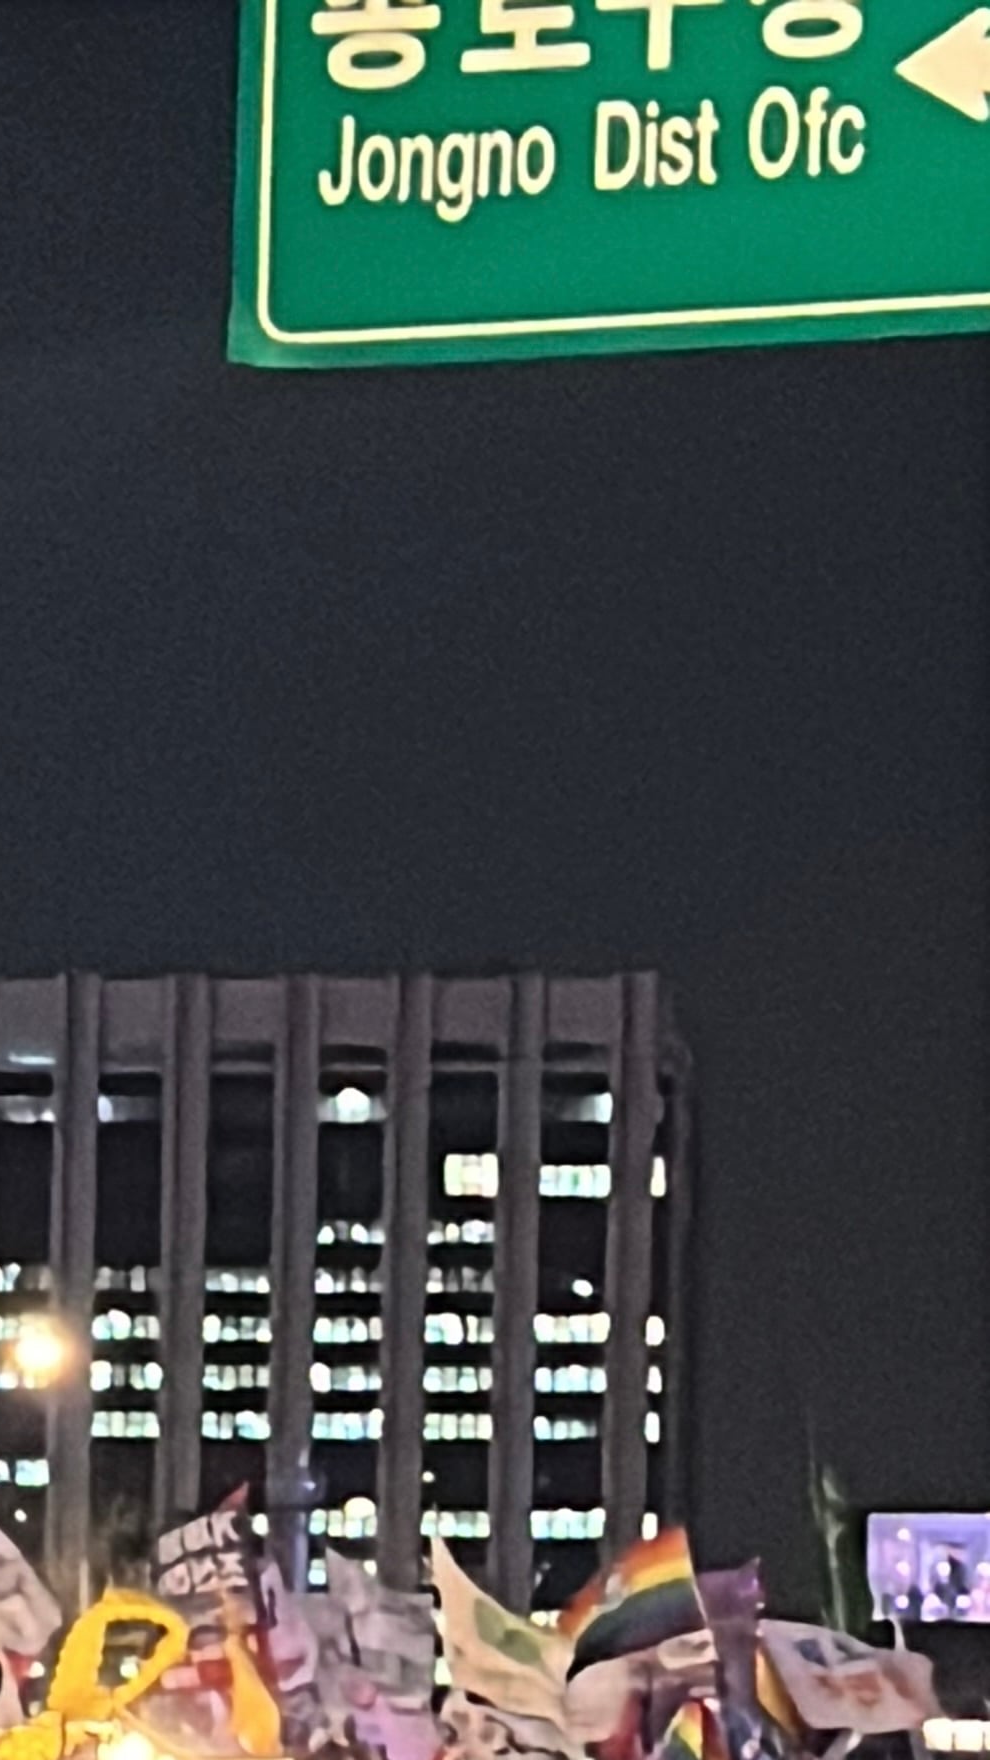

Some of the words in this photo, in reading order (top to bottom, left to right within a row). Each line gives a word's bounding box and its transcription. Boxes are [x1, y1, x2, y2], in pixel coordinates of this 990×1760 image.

[319, 115, 555, 222] Jongno
[594, 99, 719, 191] Dist
[748, 86, 866, 180] Ofc
